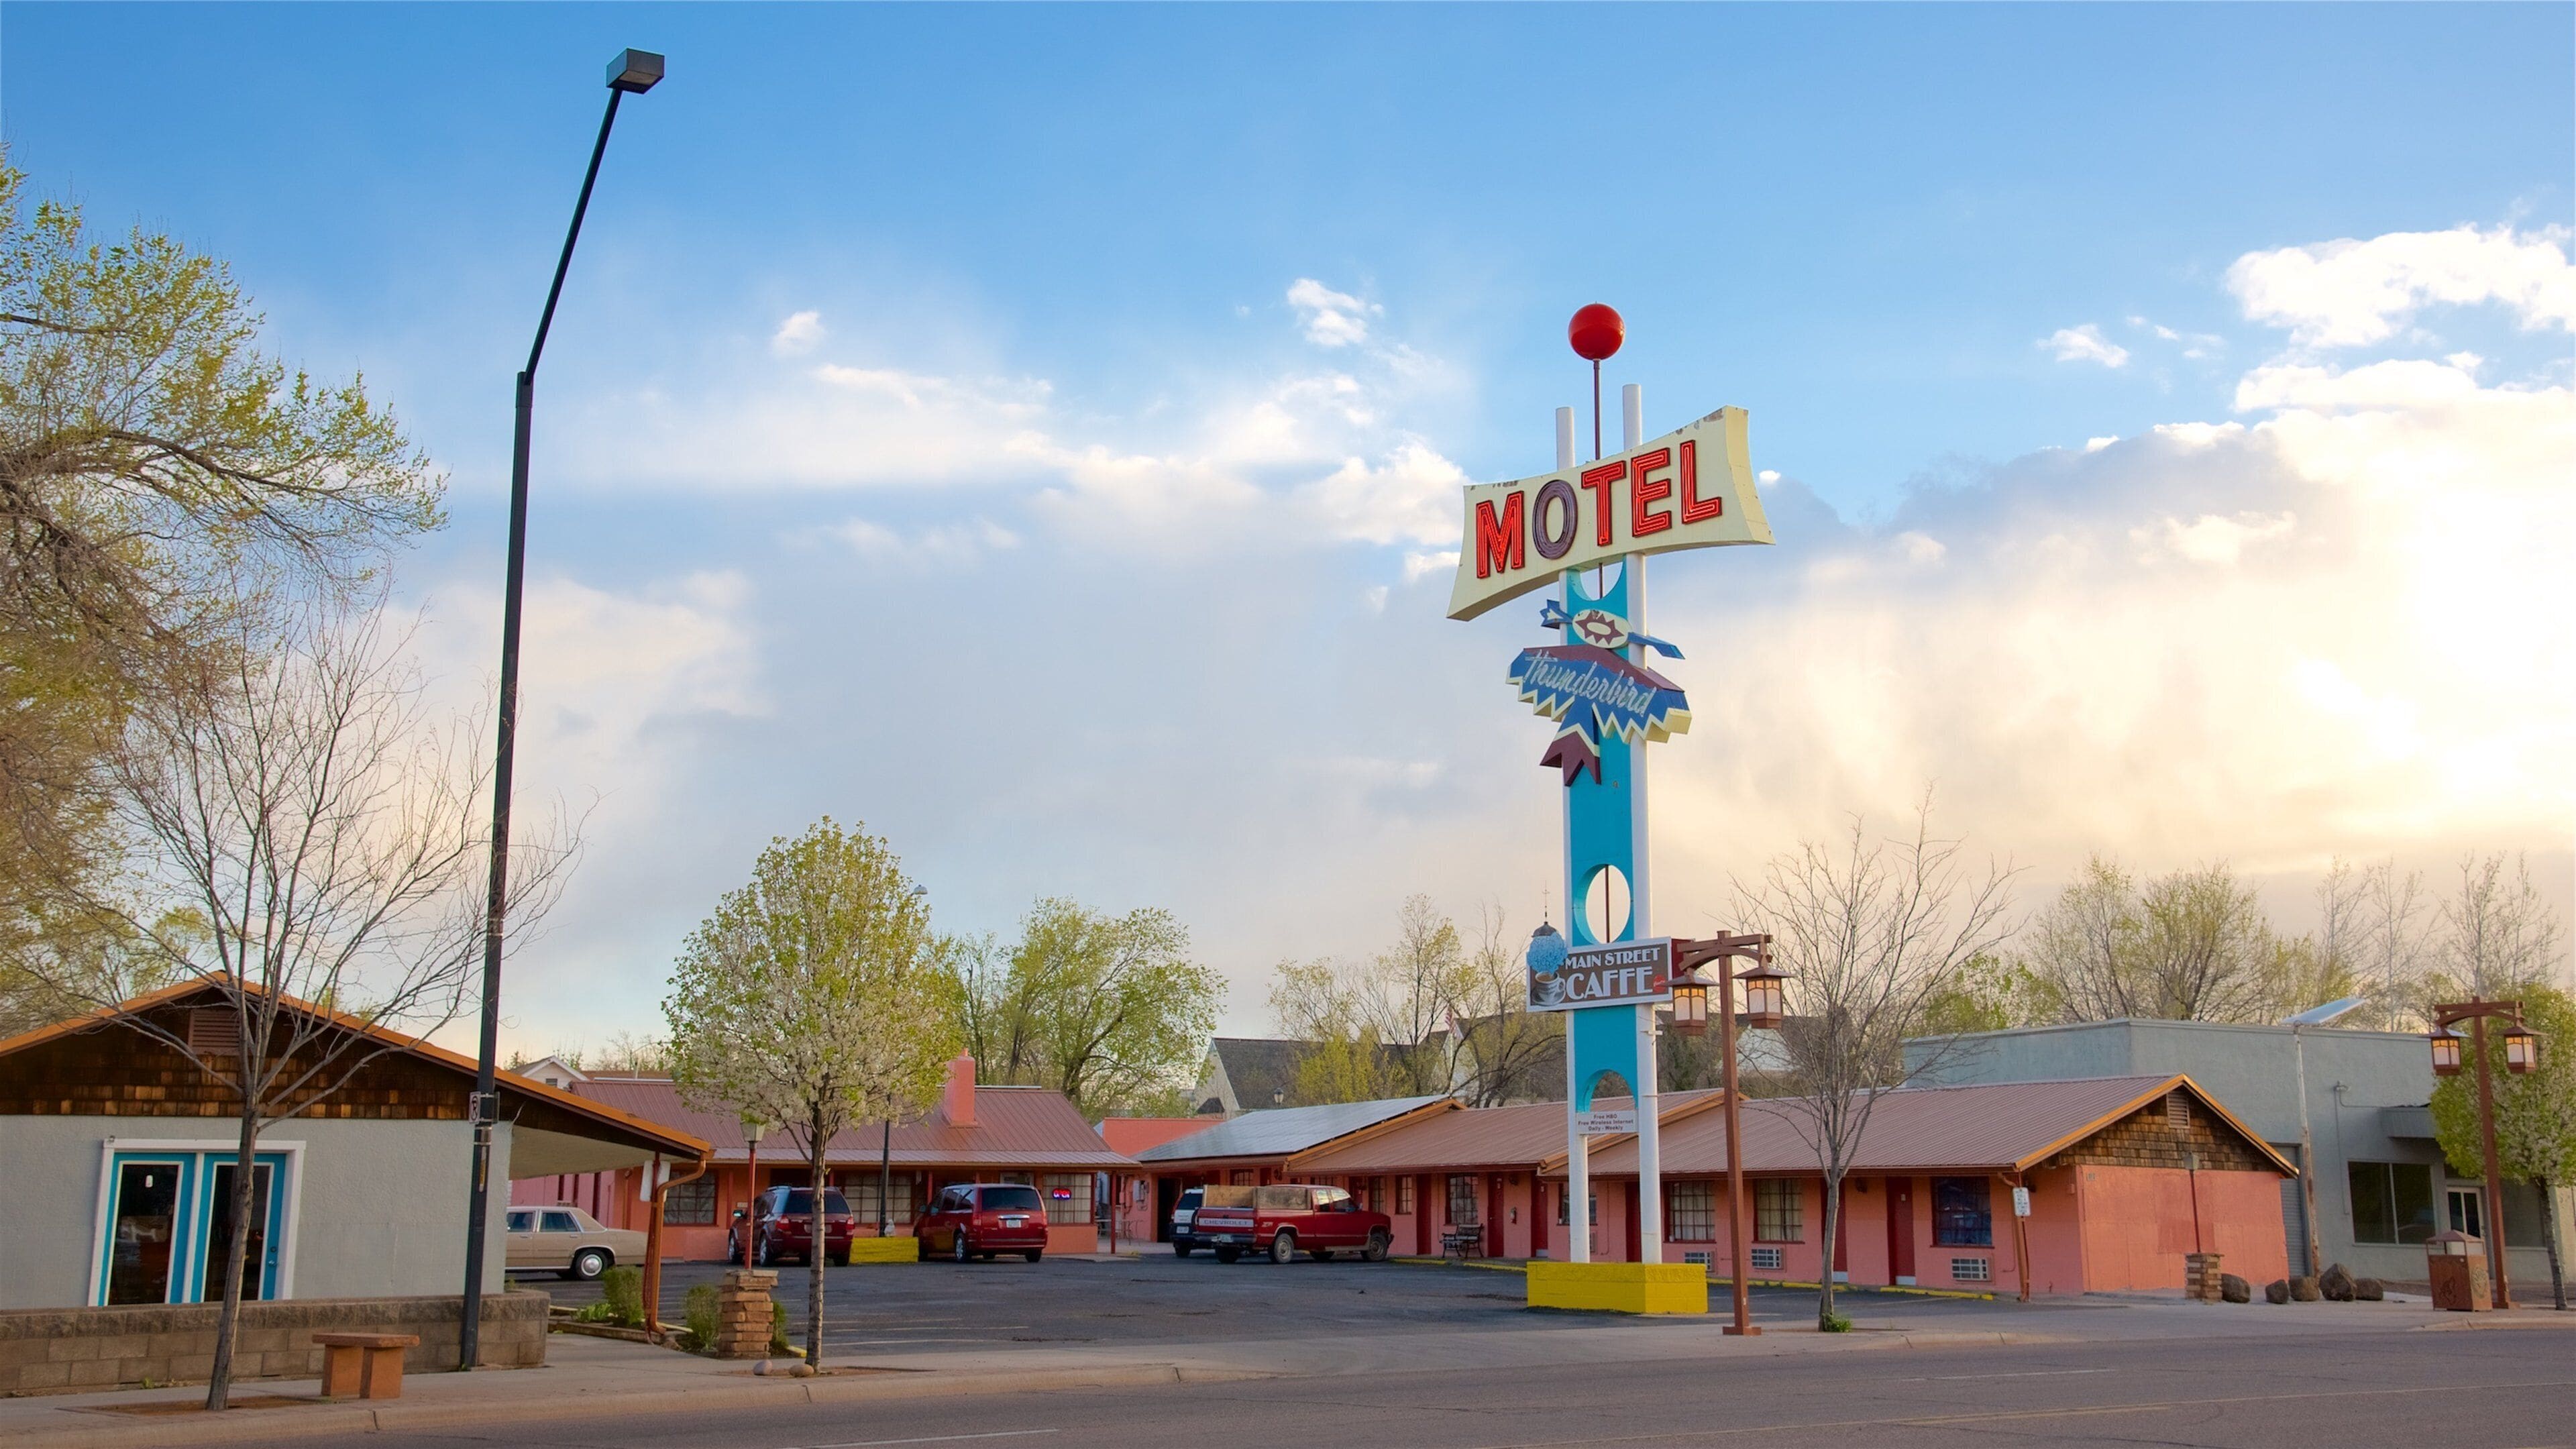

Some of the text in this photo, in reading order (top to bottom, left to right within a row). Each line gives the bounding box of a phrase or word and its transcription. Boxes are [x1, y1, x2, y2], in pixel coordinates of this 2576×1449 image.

[1476, 439, 1723, 579] MOTEL
[1565, 947, 1660, 970] MAIN STREET
[1566, 966, 1653, 1000] CAFFE
